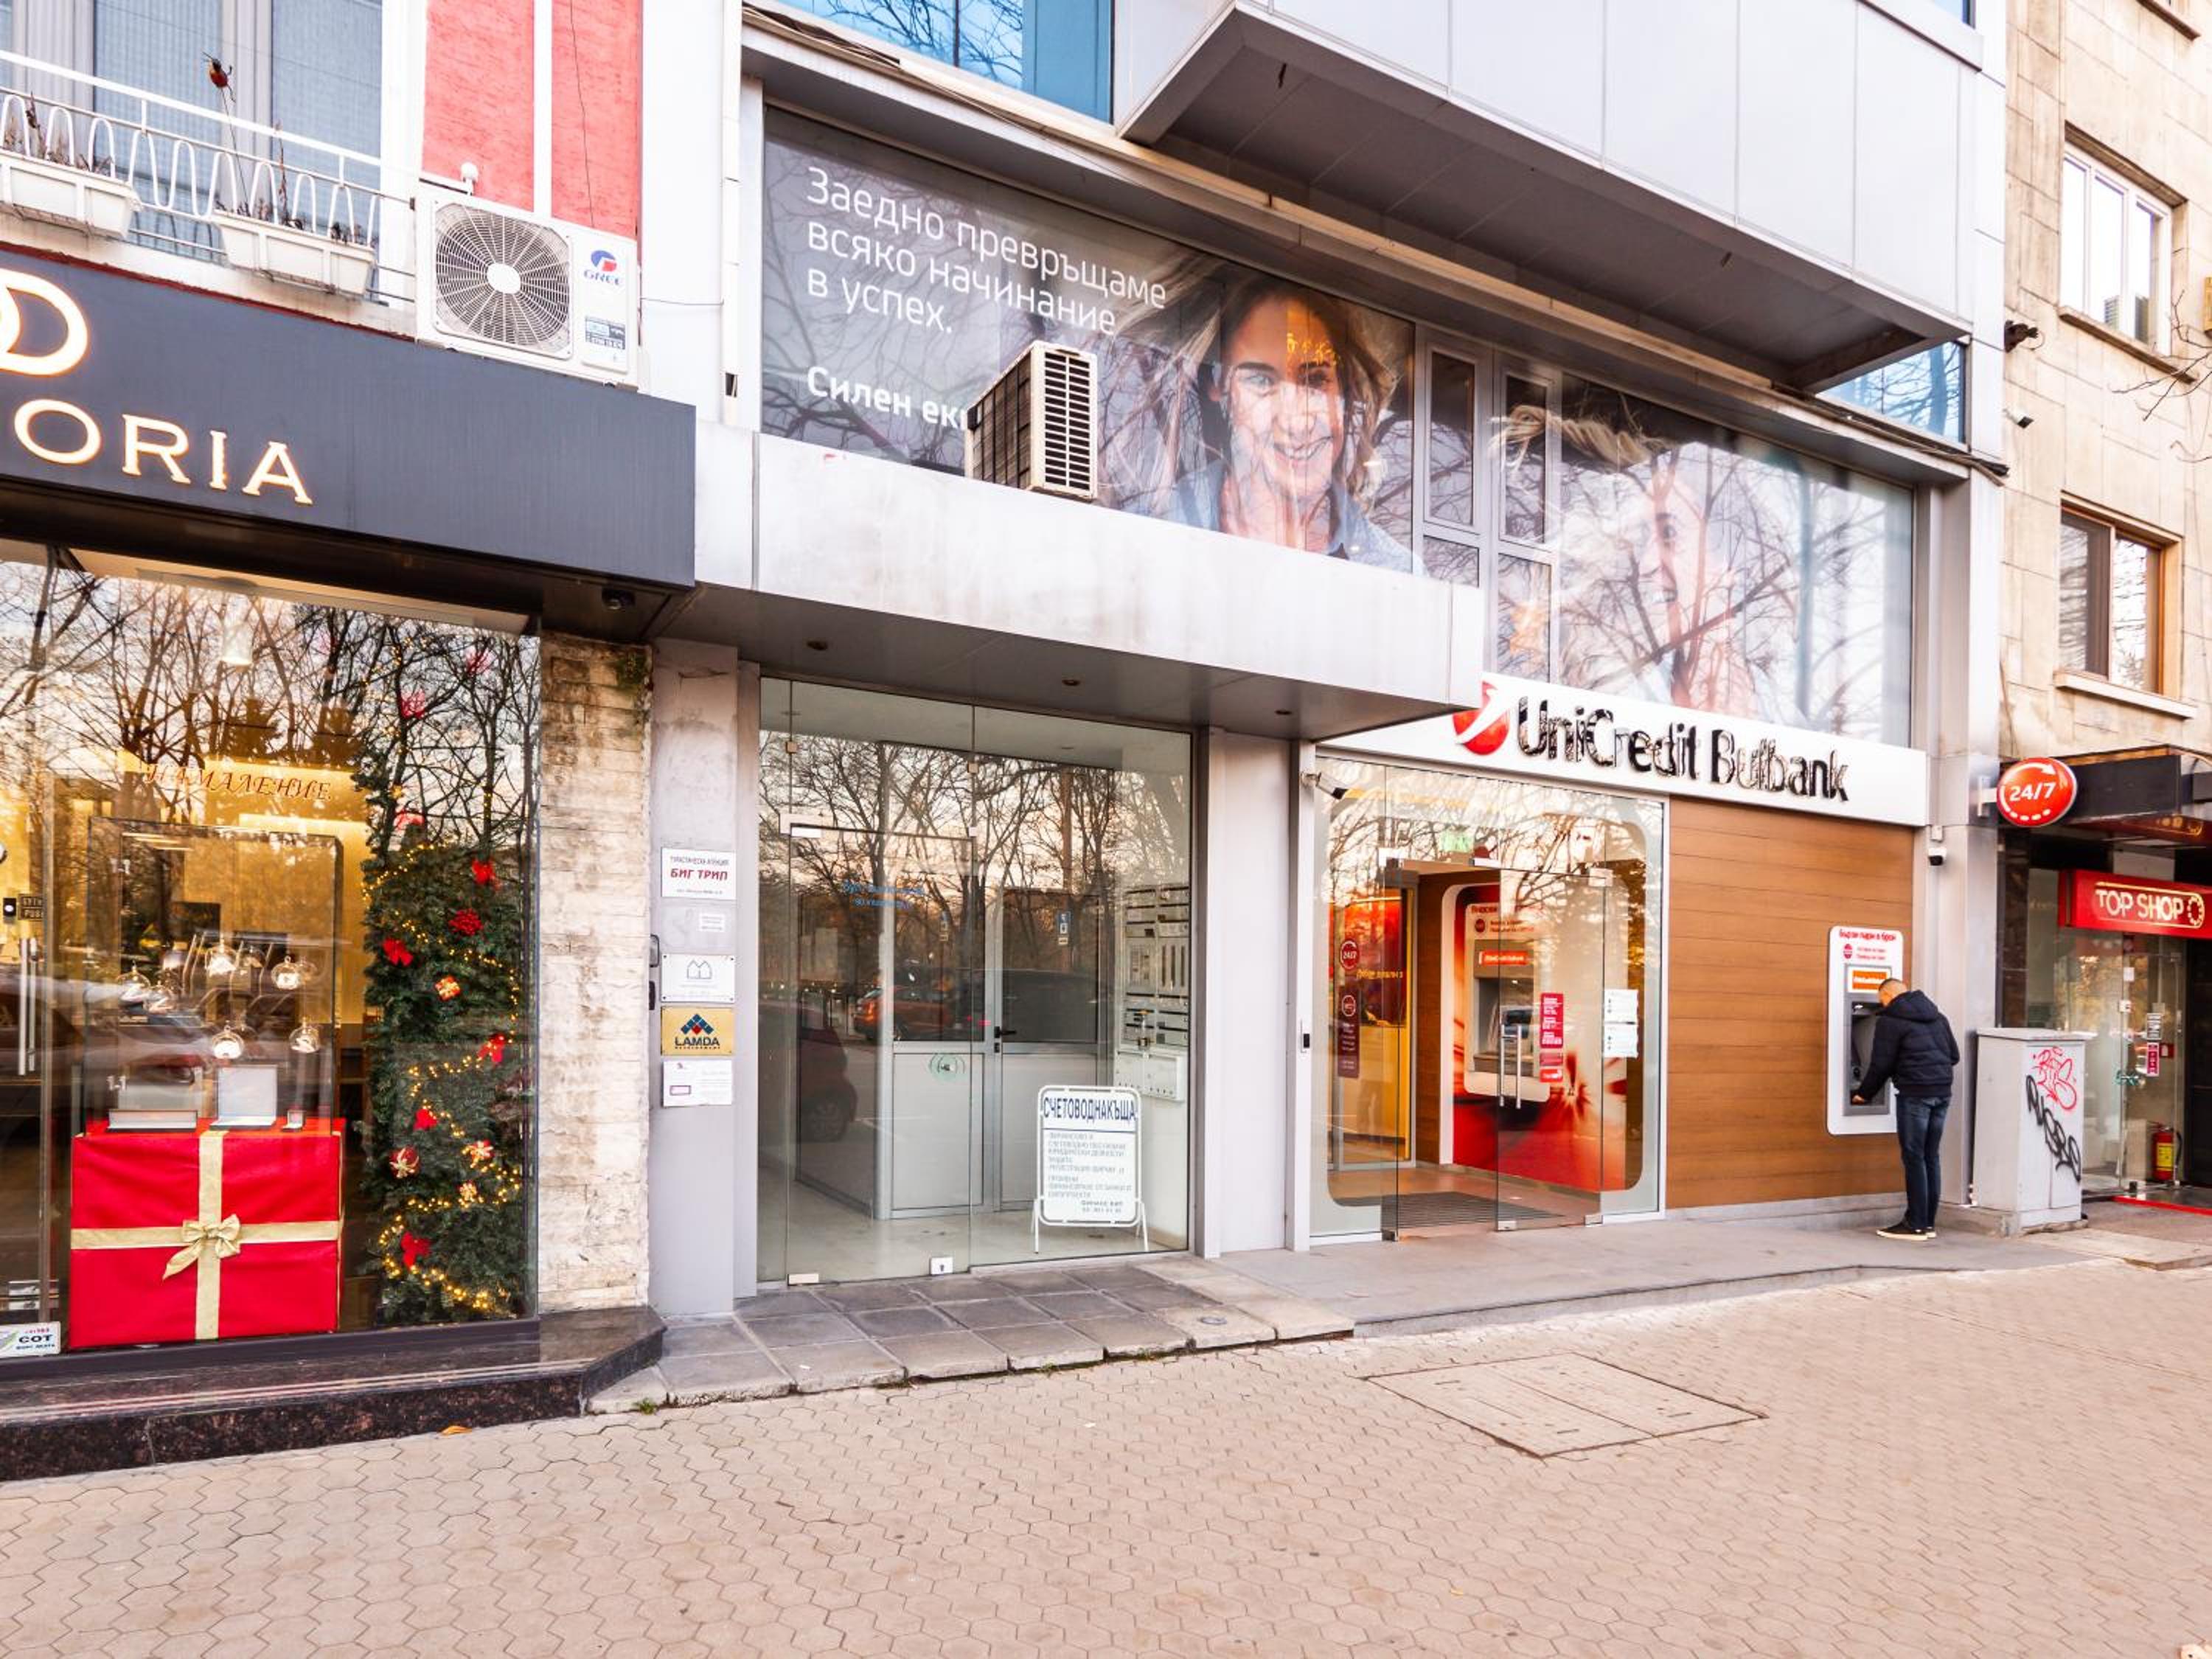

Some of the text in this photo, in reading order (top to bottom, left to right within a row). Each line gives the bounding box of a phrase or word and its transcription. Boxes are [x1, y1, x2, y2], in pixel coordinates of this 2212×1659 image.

[807, 166, 1166, 310] Заедно превръщаме
[808, 221, 1116, 335] всяко начинание
[808, 268, 953, 334] в успех.
[807, 366, 911, 418] Силен
[13, 399, 313, 505] ORIA
[1517, 695, 1851, 802] UniCredit Bulbank
[2009, 782, 2056, 802] 24/7
[670, 869, 728, 881] БИГ ТРИП
[2095, 889, 2184, 921] TOP SHOP
[674, 1036, 720, 1046] LAMDA
